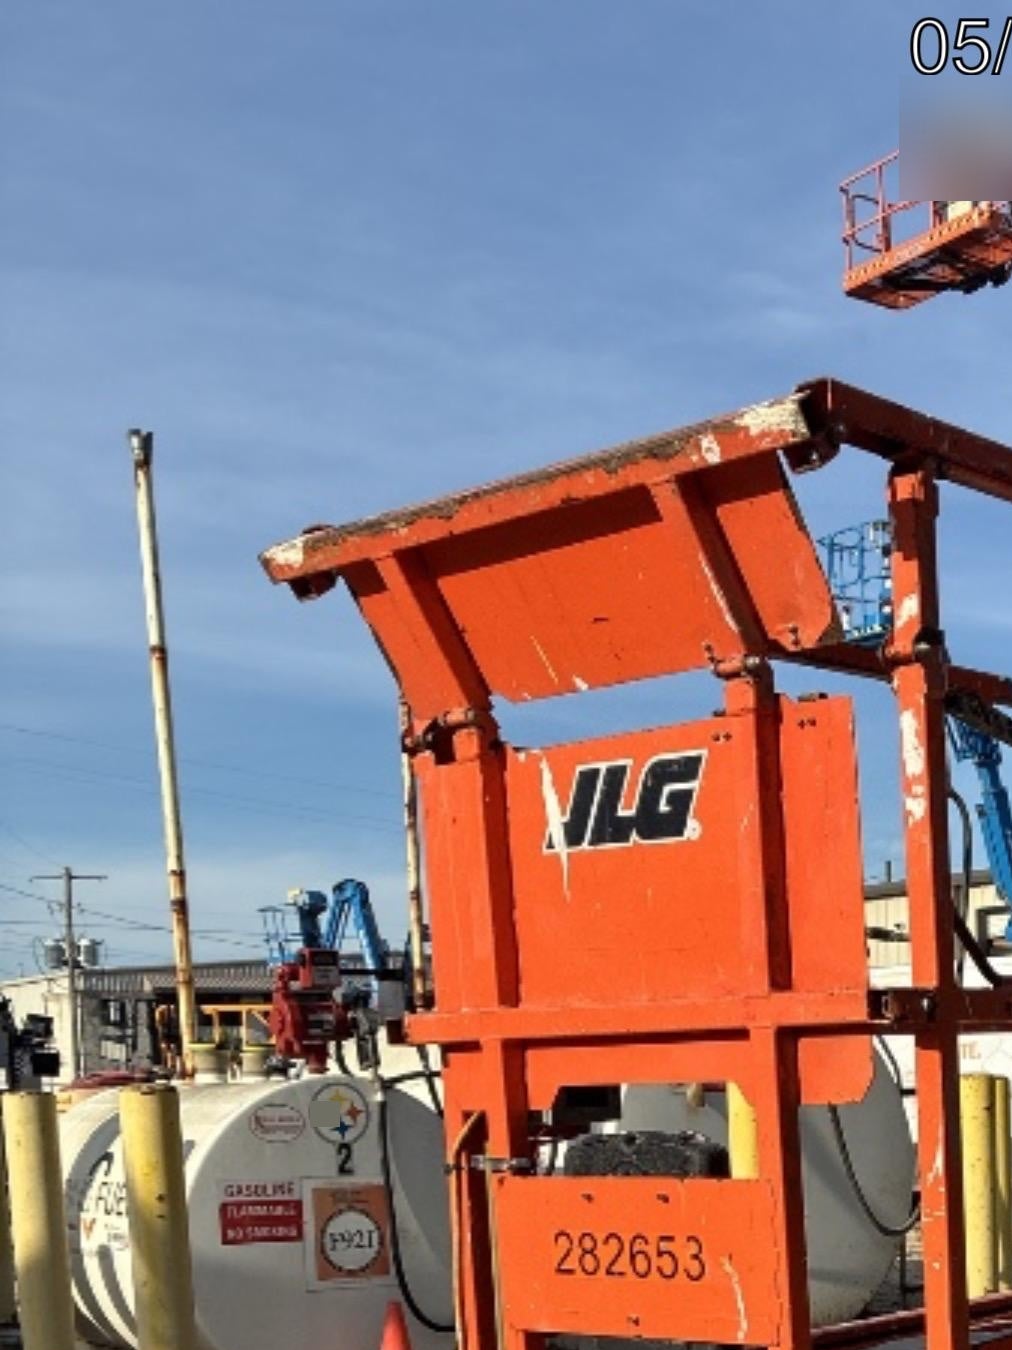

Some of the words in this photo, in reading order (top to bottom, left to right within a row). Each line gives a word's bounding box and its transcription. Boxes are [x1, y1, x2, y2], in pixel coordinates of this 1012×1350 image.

[543, 750, 708, 853] JLG
[337, 1142, 354, 1175] 2
[223, 1182, 295, 1198] GASOLINE
[553, 1230, 706, 1281] 282653
